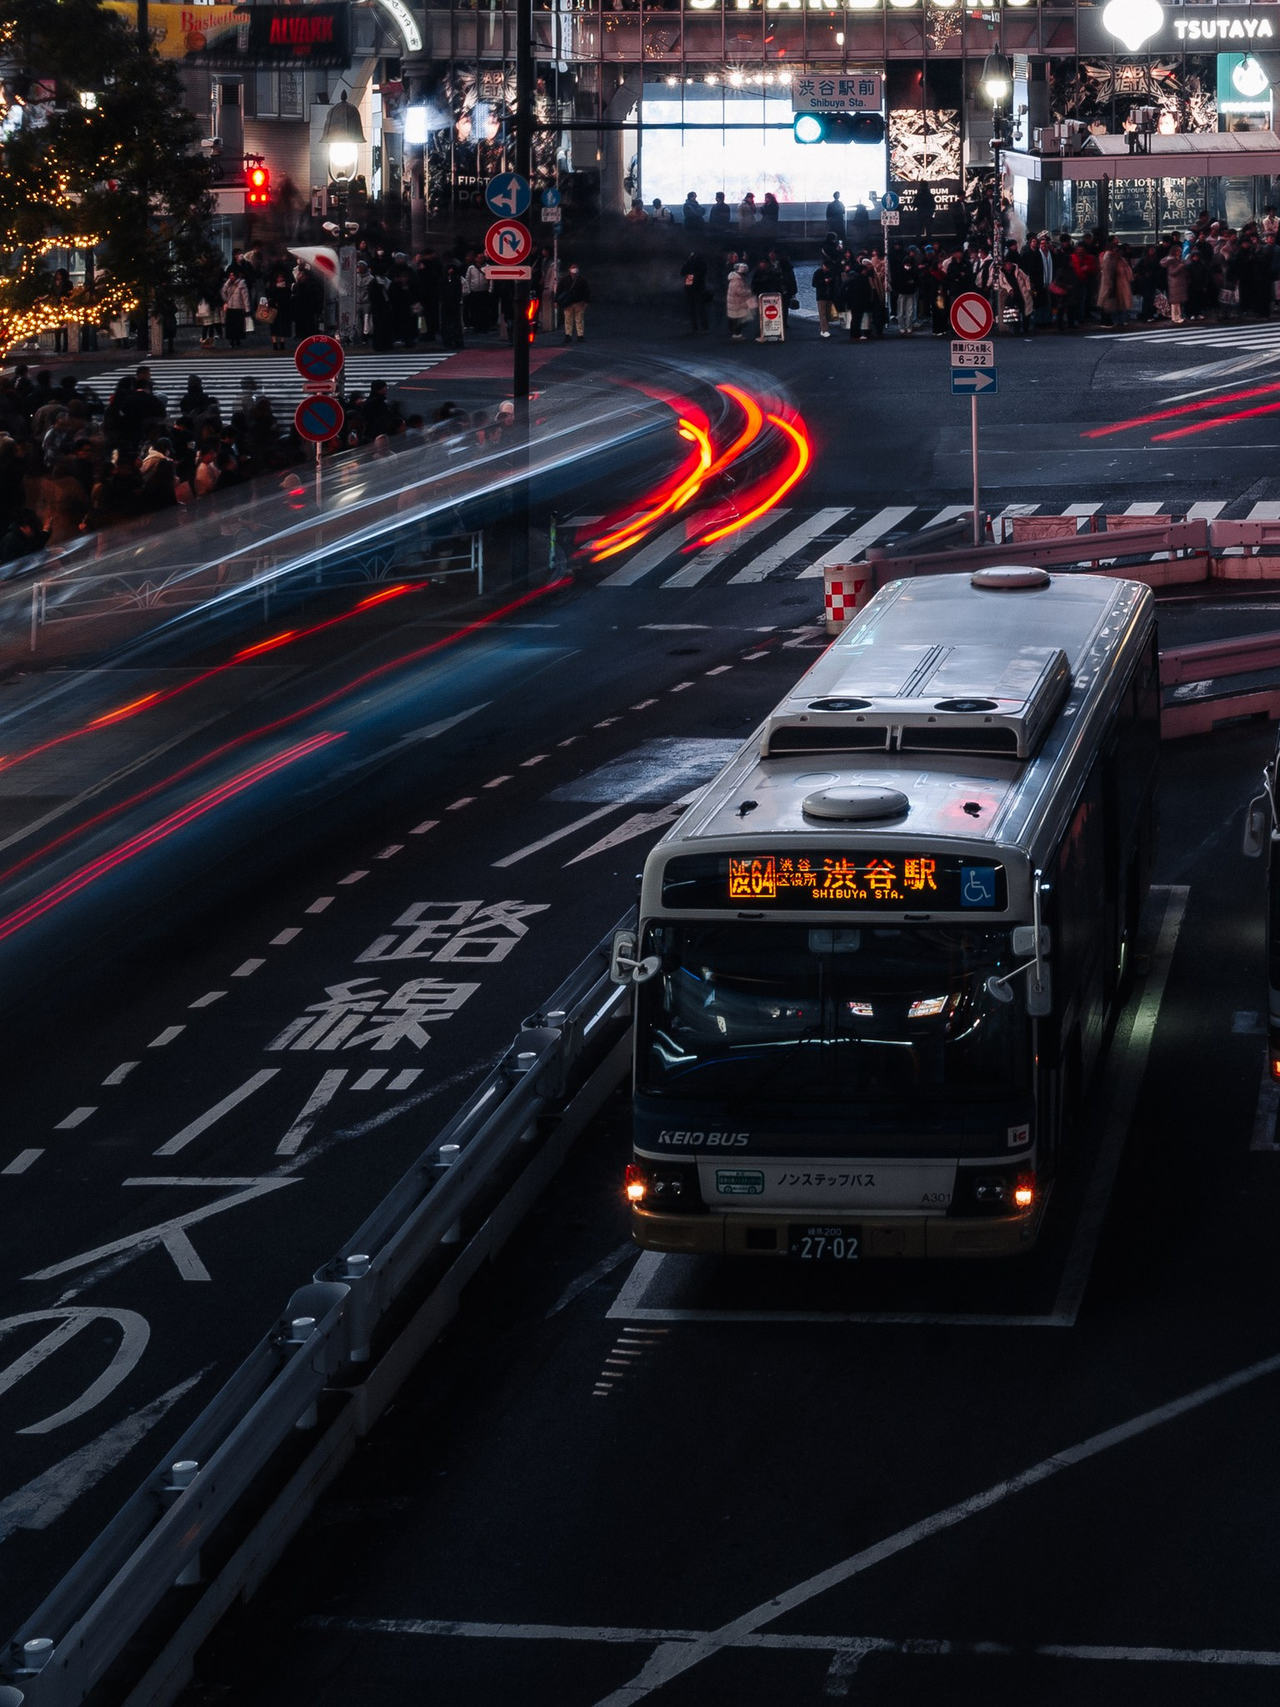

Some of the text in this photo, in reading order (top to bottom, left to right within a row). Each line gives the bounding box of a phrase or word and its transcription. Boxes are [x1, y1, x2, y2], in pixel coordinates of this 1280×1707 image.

[1174, 18, 1273, 39] TSUTAYA
[799, 80, 875, 96] 渋谷駅前
[810, 97, 866, 108] Shibuya Sta.
[958, 354, 987, 365] 6-22
[779, 857, 812, 872] 渋谷
[776, 872, 817, 887] 区役所
[822, 856, 938, 891] 渋谷駅
[812, 888, 905, 900] SHIBUYA STA.
[658, 1130, 750, 1147] KEIO BUS
[777, 1173, 877, 1188] ノンステップバス
[921, 1193, 951, 1204] A301
[800, 1237, 858, 1260] 27-02
